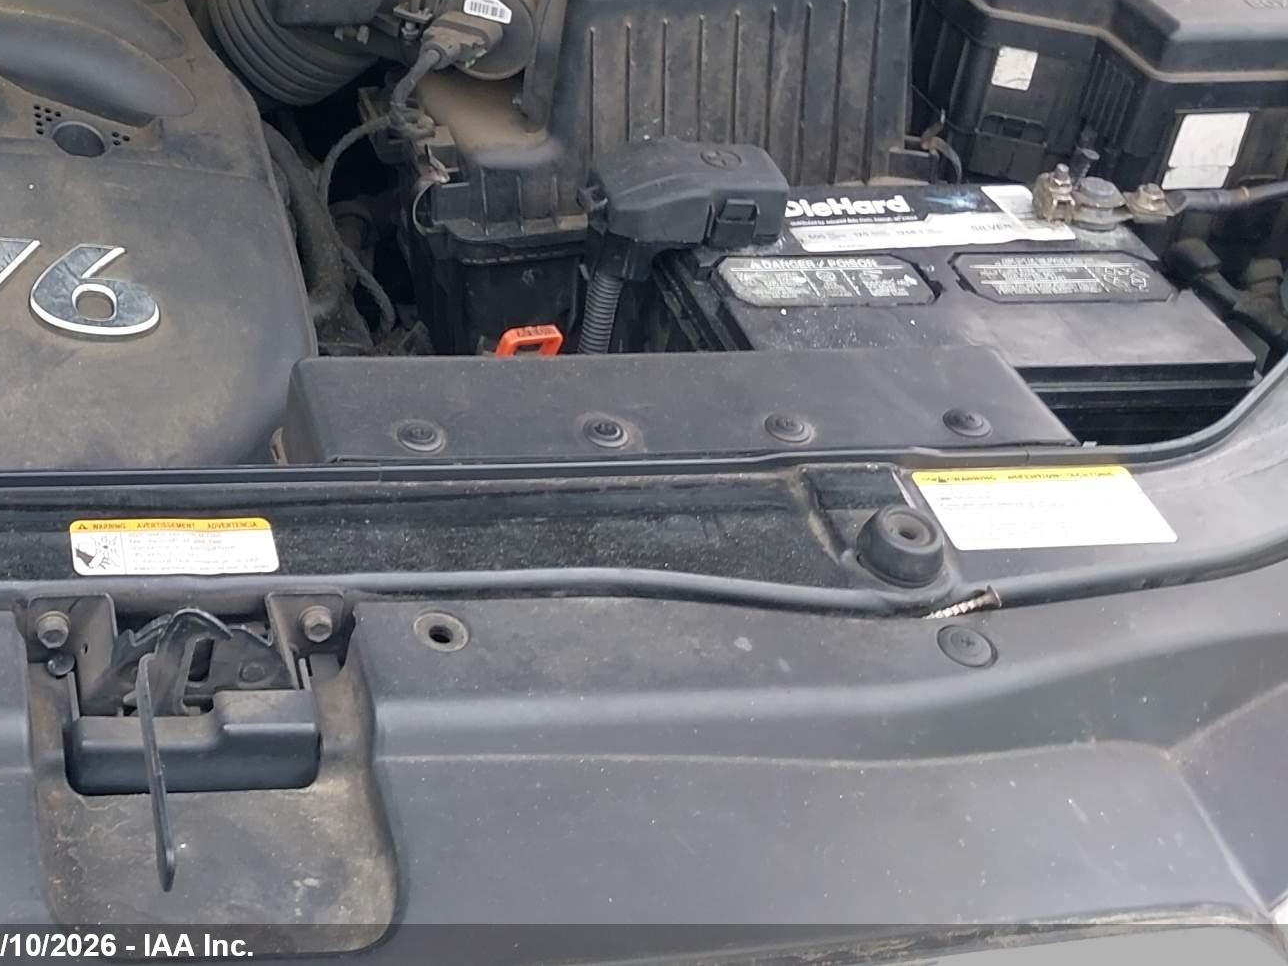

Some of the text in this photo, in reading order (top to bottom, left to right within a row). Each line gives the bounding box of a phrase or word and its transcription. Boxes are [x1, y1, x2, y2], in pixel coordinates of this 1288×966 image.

[784, 195, 911, 218] DieHard
[827, 258, 878, 269] POISON
[92, 522, 127, 531] WARNING
[136, 521, 196, 530] AVERTISSEMENT
